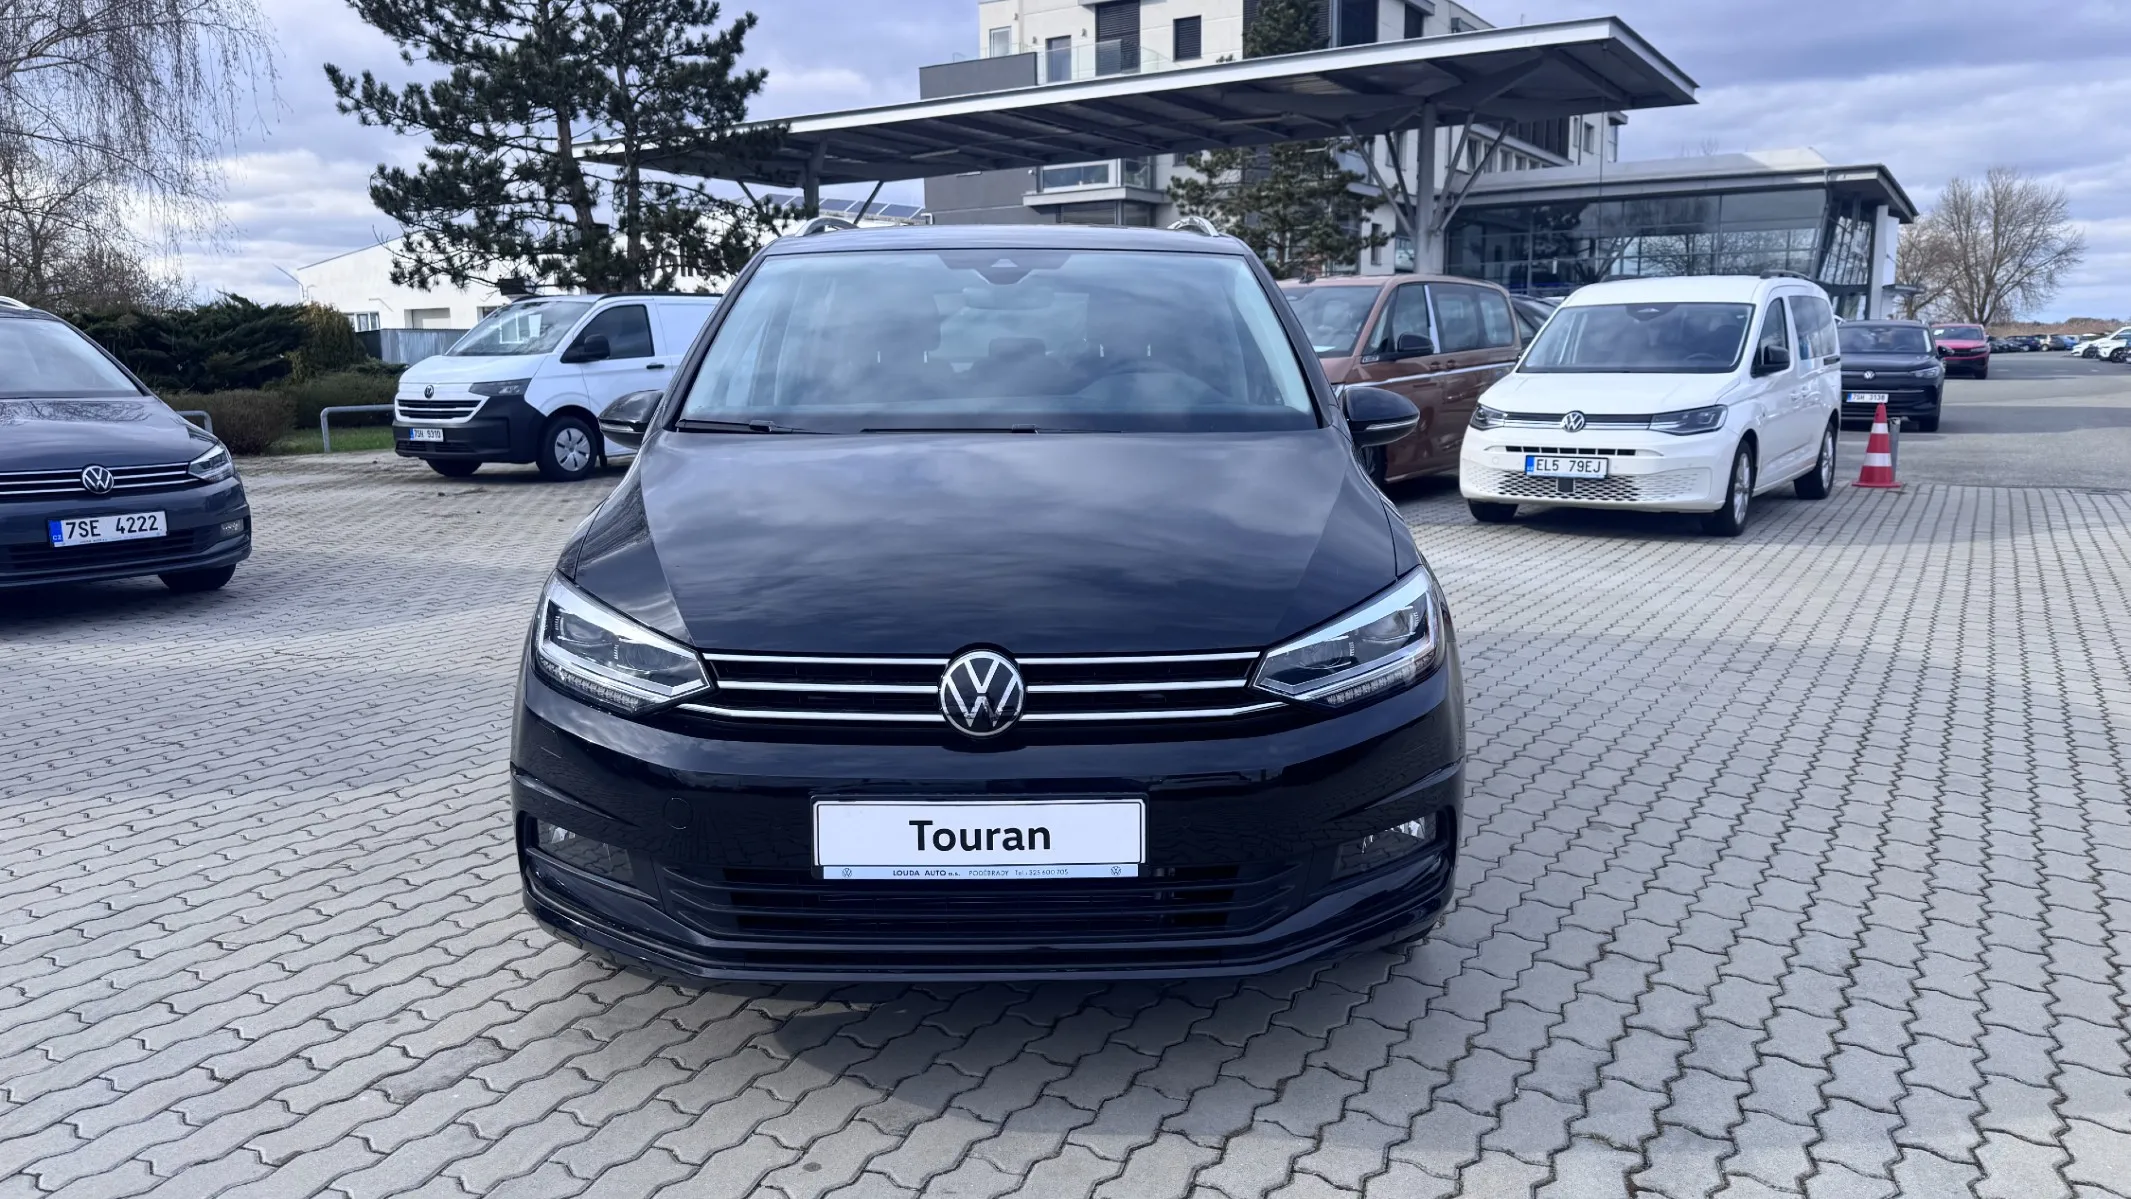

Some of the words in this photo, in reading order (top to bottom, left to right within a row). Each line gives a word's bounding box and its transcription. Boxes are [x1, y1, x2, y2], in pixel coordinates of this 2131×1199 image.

[1536, 459, 1559, 471] EL5
[1569, 460, 1601, 473] 79EJ
[65, 520, 101, 540] 7SE
[115, 515, 159, 535] 4222
[908, 819, 1051, 852] Touran
[892, 869, 920, 877] LOUDA
[924, 869, 947, 877] AUTO
